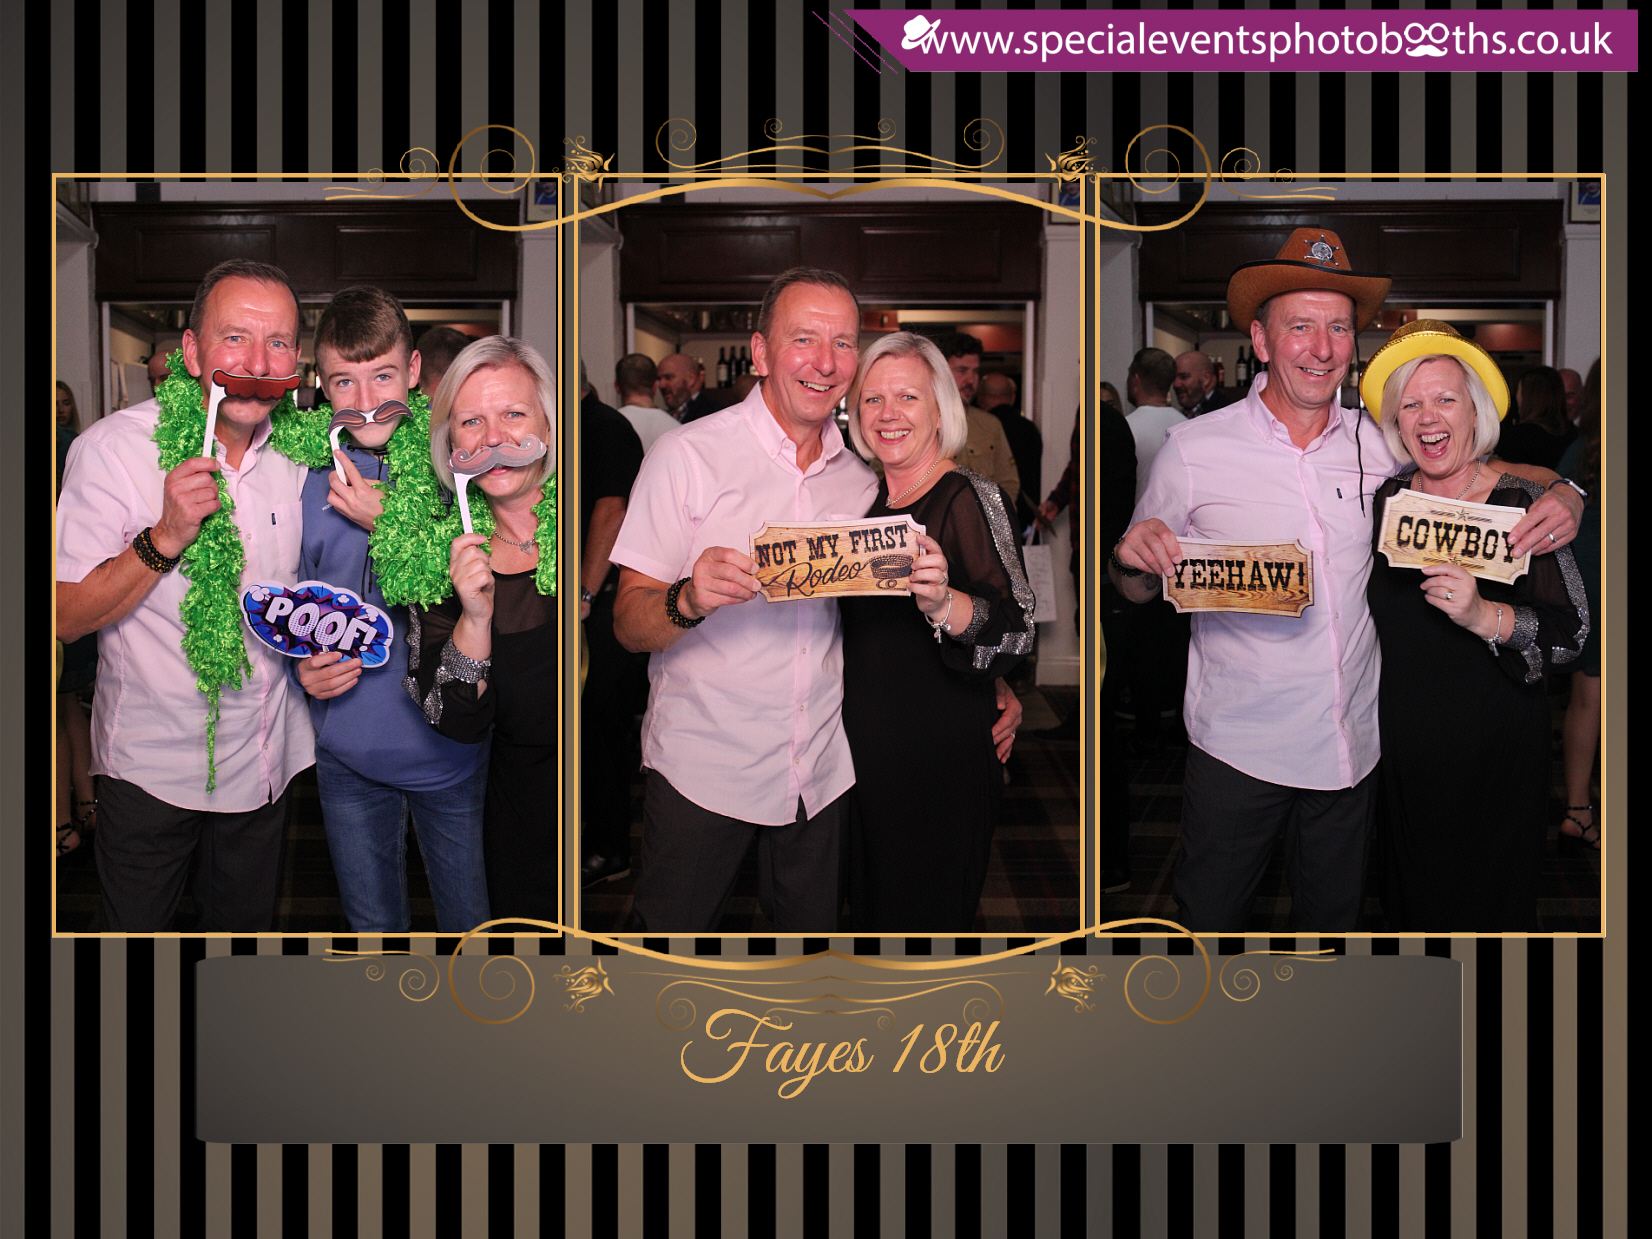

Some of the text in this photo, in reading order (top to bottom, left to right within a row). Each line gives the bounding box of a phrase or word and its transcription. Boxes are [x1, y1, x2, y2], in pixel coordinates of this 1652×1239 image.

[755, 524, 908, 568] NOT MY FIRST
[762, 556, 865, 597] Rodeo
[1174, 558, 1305, 595] YEEHAW!
[265, 597, 377, 651] POOF!
